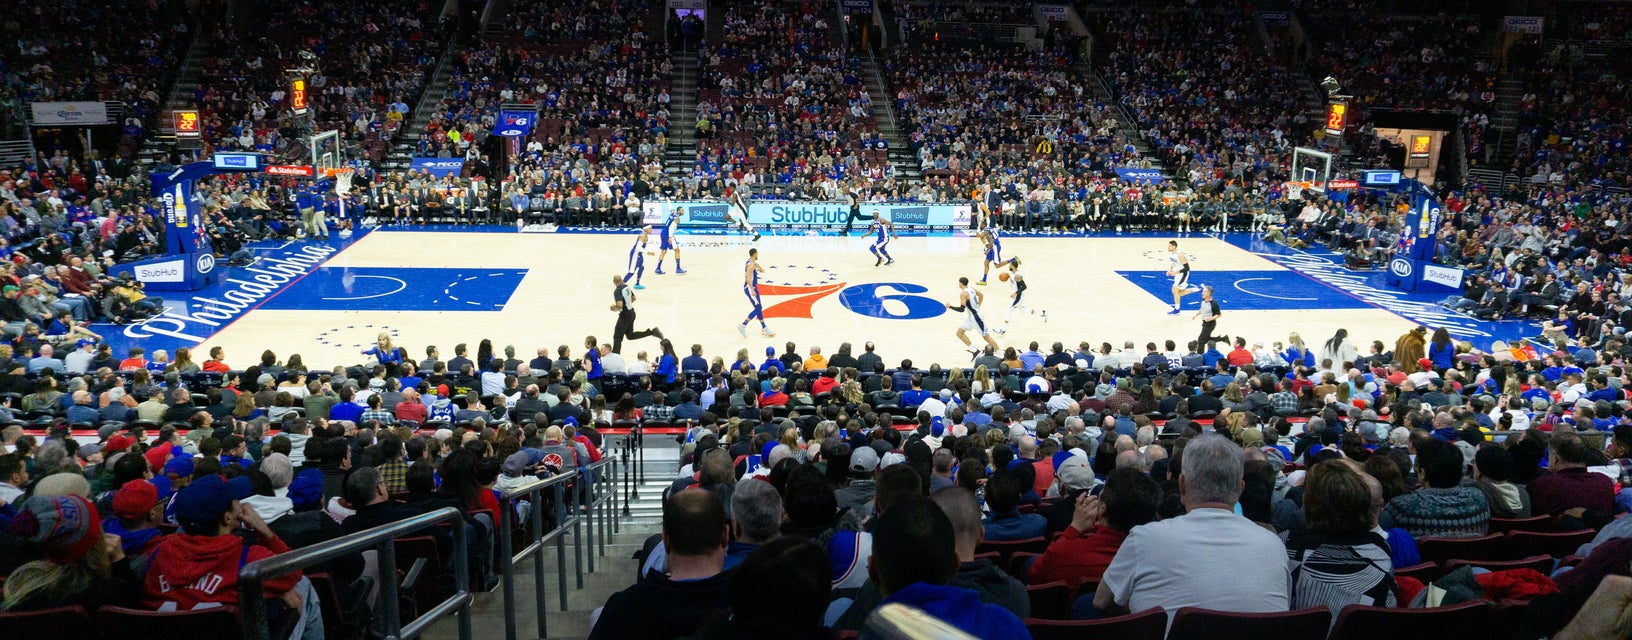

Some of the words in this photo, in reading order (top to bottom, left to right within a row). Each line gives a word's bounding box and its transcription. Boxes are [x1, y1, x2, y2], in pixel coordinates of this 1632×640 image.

[163, 192, 175, 224] Corona
[771, 206, 849, 223] StubHub
[141, 268, 178, 278] StubHub
[1428, 269, 1457, 282] StubHub
[123, 244, 337, 343] Philadelphia
[757, 282, 947, 319] 76
[1167, 359, 1180, 368] 25
